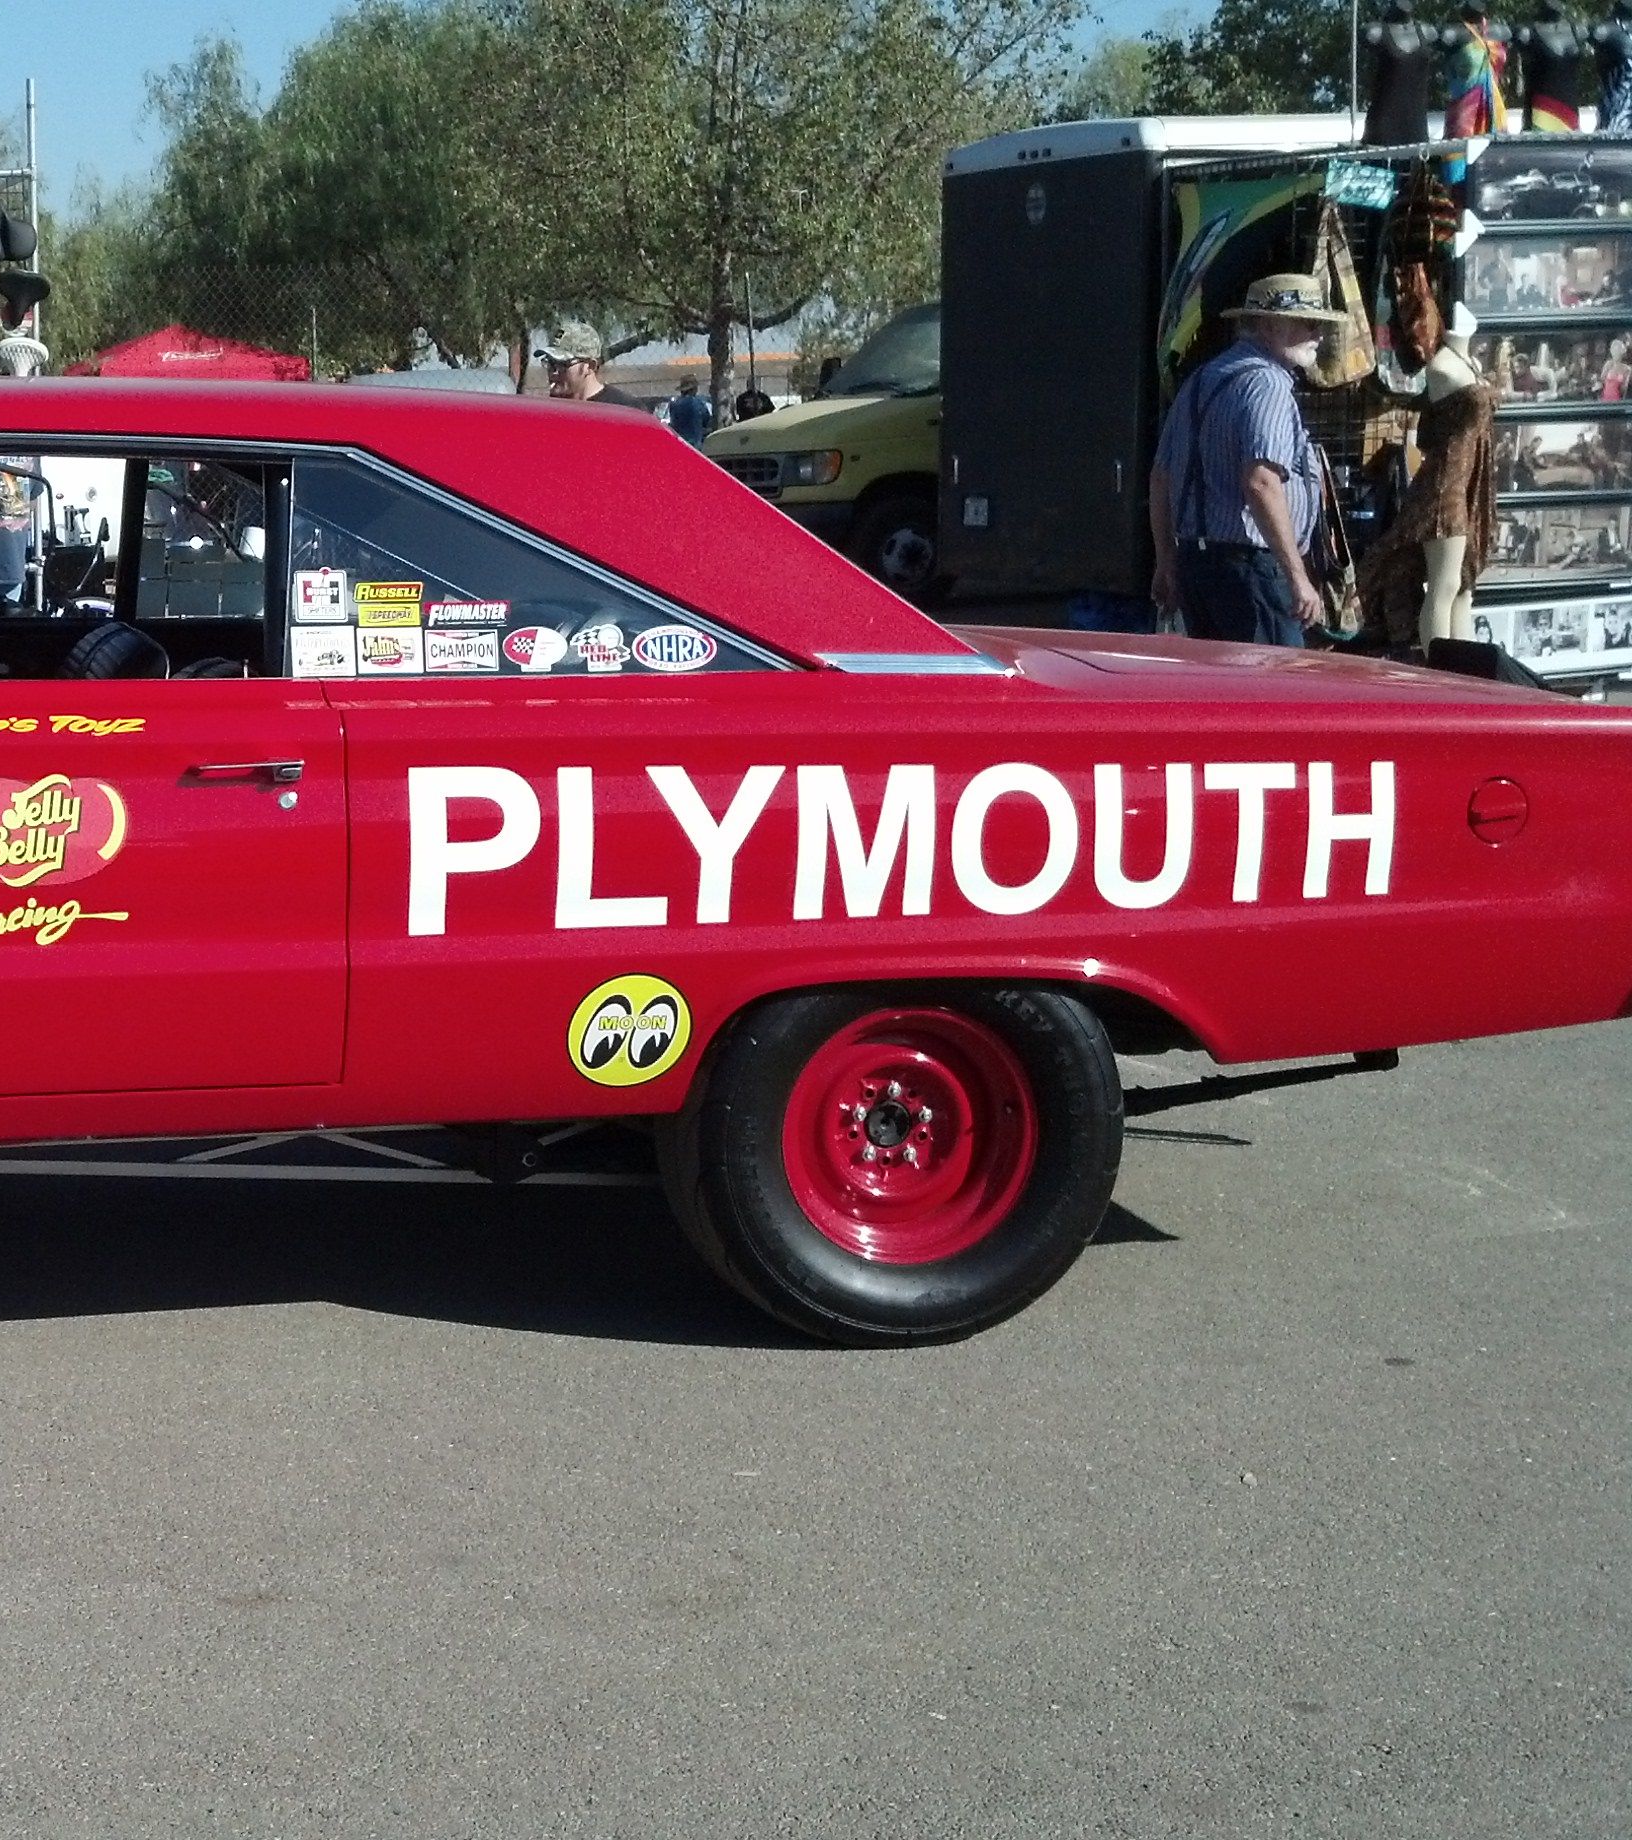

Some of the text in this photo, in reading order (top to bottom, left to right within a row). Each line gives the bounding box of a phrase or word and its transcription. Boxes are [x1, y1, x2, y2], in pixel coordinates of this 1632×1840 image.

[356, 585, 419, 600] RUSSELL
[428, 603, 508, 627] FLOWMASTER
[430, 643, 494, 658] CHAMPION
[589, 653, 619, 663] LINE
[646, 634, 705, 662] NHRA
[49, 715, 146, 737] Toyz
[2, 774, 82, 835] Jelly
[406, 761, 1396, 936] PLYMOUTH
[598, 1014, 668, 1032] MOON
